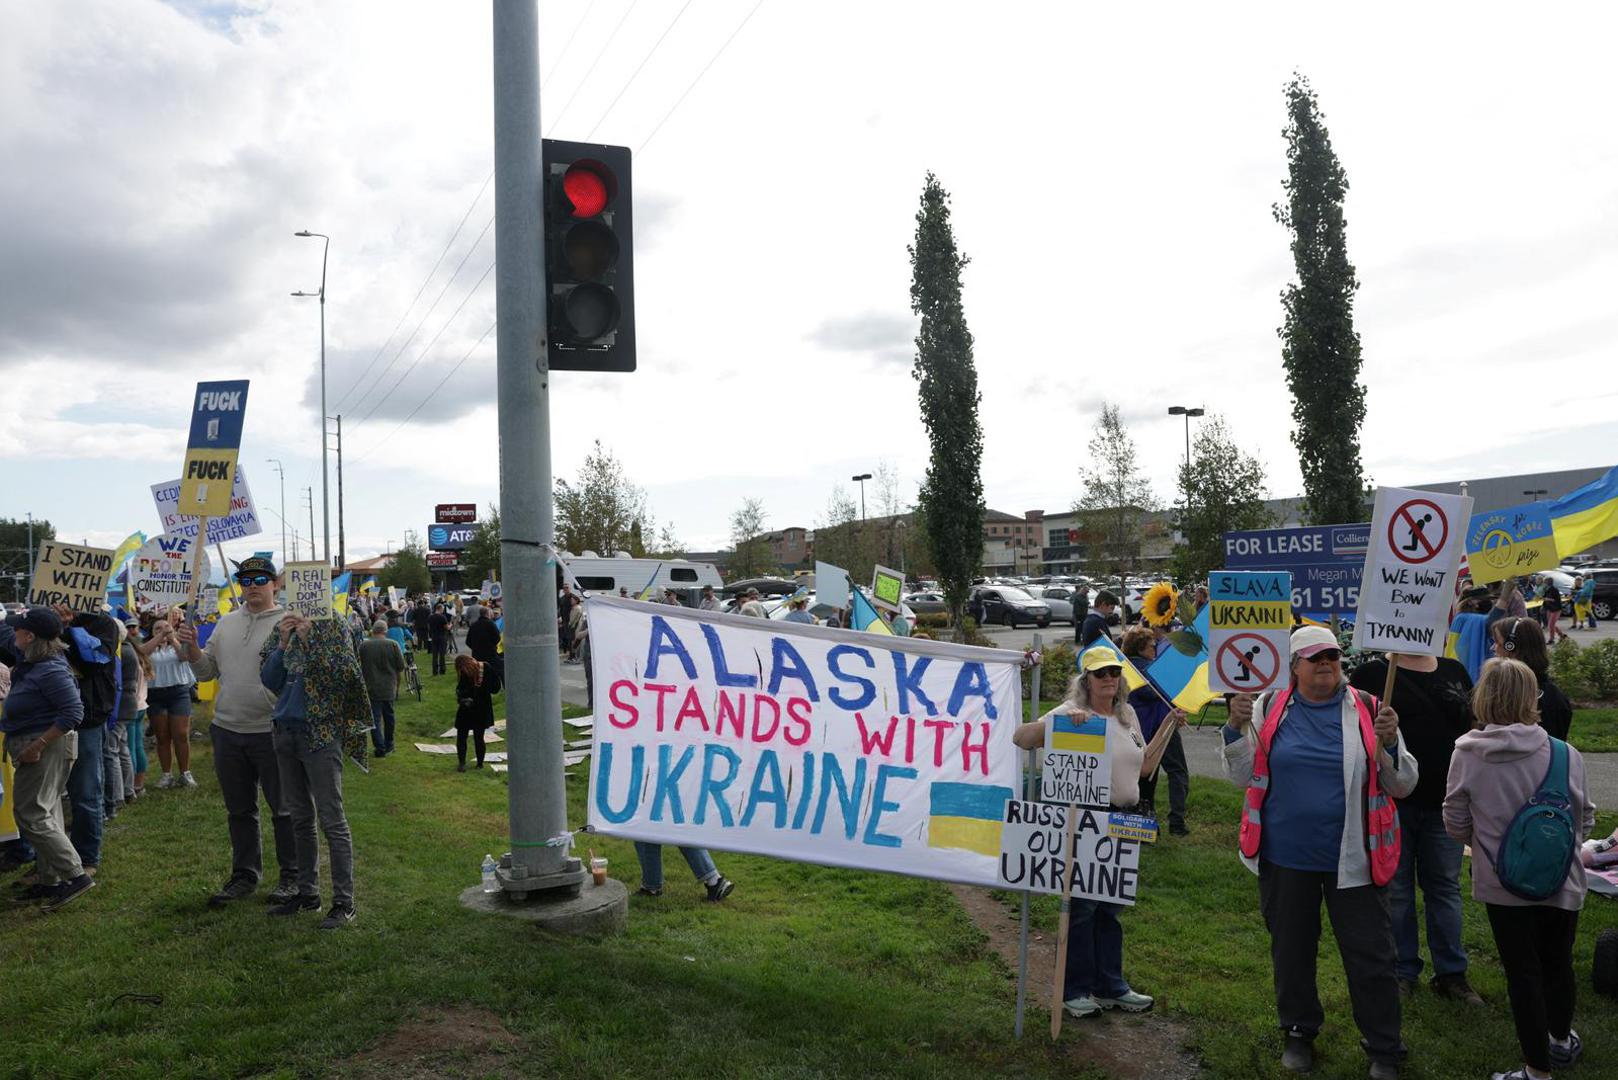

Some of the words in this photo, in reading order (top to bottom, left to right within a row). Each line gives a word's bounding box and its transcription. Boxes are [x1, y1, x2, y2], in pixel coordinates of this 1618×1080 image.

[198, 391, 241, 411] FUCK
[188, 461, 230, 480] FUCK
[207, 525, 247, 544] HITLER
[450, 530, 475, 542] AT&
[158, 537, 191, 552] WE
[1226, 538, 1262, 555] FOR
[1267, 534, 1323, 554] LEASE
[42, 545, 54, 563] I
[60, 548, 112, 571] STAND
[140, 558, 192, 574] PEOPL
[53, 569, 102, 591] WITH
[292, 569, 328, 582] REAL
[1308, 568, 1348, 583] Megan
[1382, 568, 1409, 585] WE
[299, 581, 322, 591] MEN
[1218, 577, 1284, 597] SLAVA
[30, 589, 104, 613] UKRAINE
[288, 598, 323, 611] START
[301, 606, 328, 618] WARS
[1211, 604, 1283, 625] UKRAINI
[1366, 622, 1434, 646] TYRANNY
[644, 615, 998, 720] ALASKA
[608, 680, 814, 746] STANDS
[855, 712, 990, 776] WITH
[1044, 753, 1099, 769] STAND
[1052, 768, 1093, 785] WITH
[597, 742, 919, 848] UKRAINE
[1043, 781, 1109, 805] UKRAINE
[1007, 800, 1100, 834] RUSSA
[1112, 815, 1155, 825] SOLIDARITY
[1111, 826, 1153, 839] UKRAINE
[1095, 835, 1139, 866] OF
[1002, 853, 1138, 900] UKRAINE
